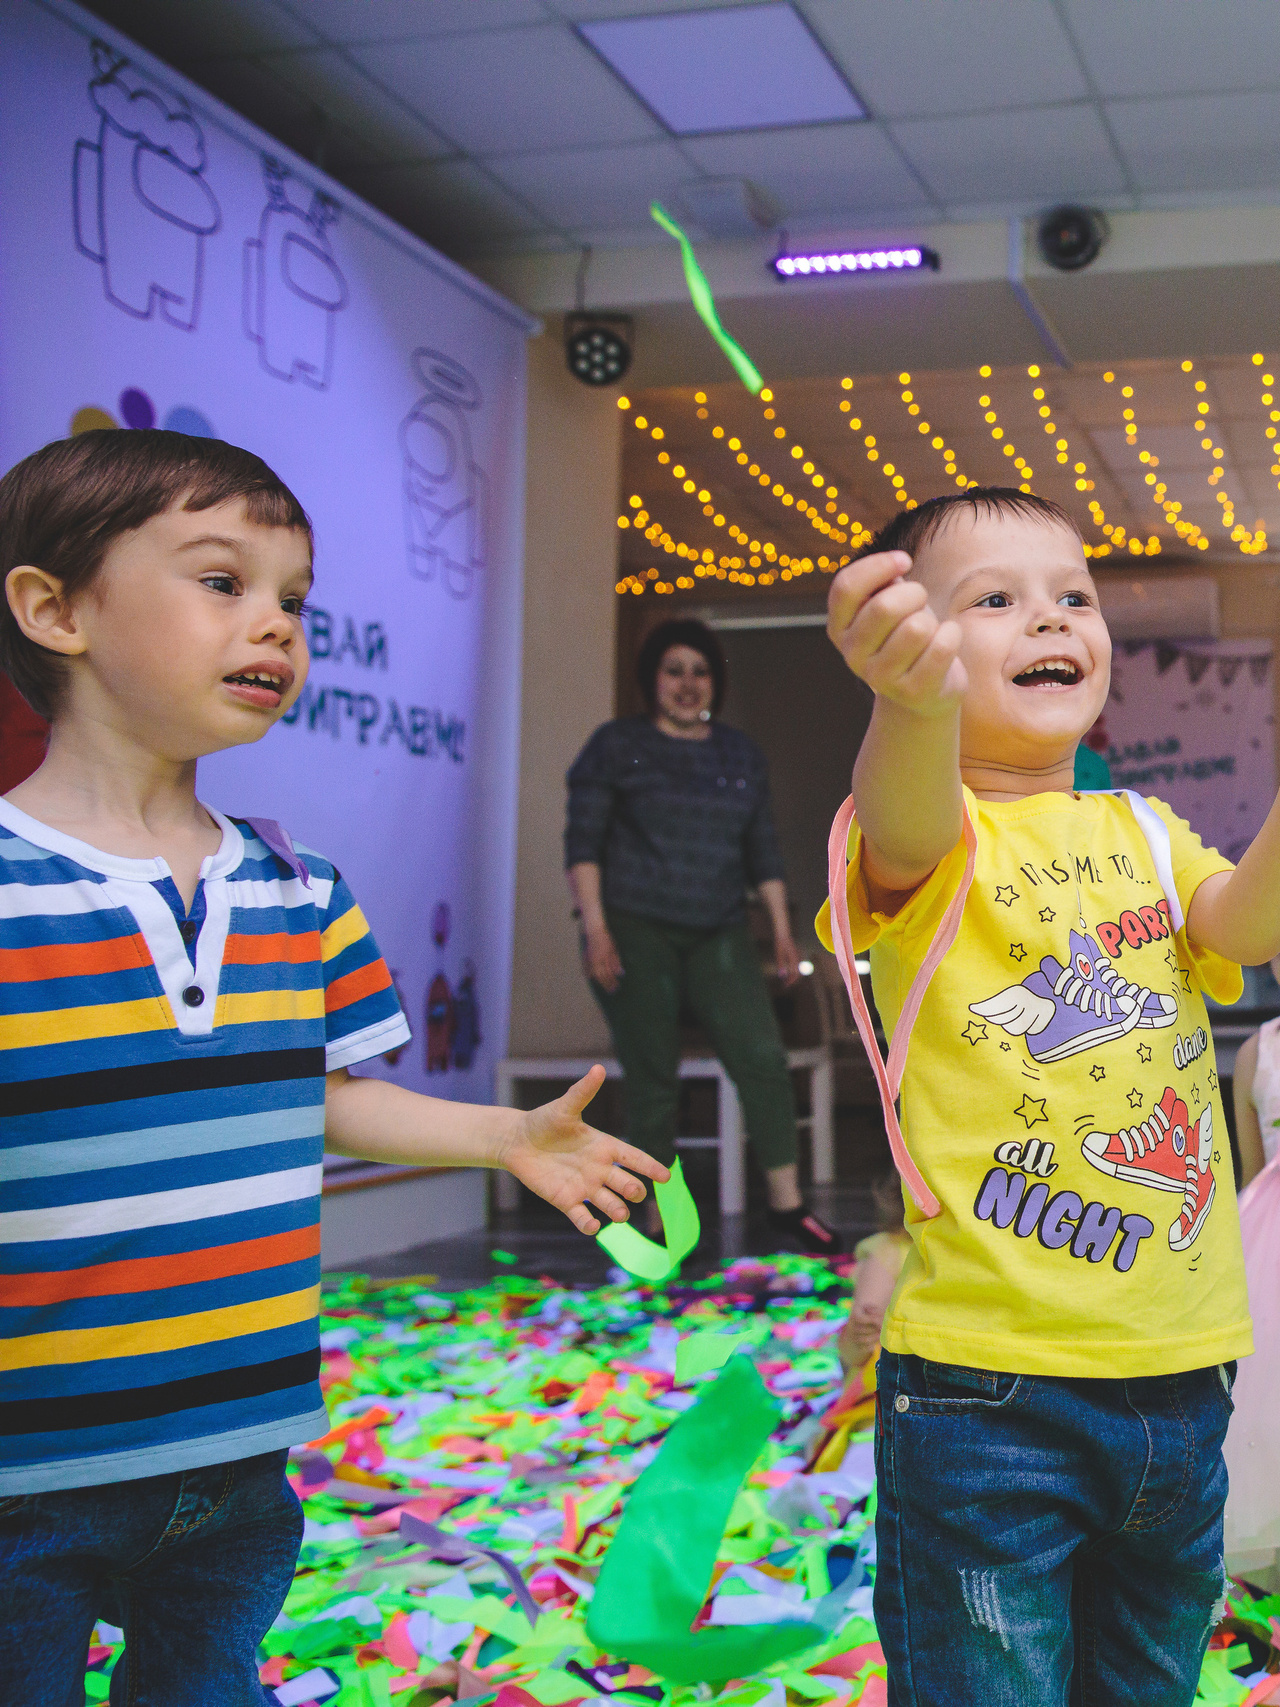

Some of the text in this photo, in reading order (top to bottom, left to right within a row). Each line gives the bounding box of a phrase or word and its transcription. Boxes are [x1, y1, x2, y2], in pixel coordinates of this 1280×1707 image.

[1041, 859, 1070, 886] IS
[994, 1138, 1059, 1178] all
[973, 1167, 1155, 1273] NIGHT
